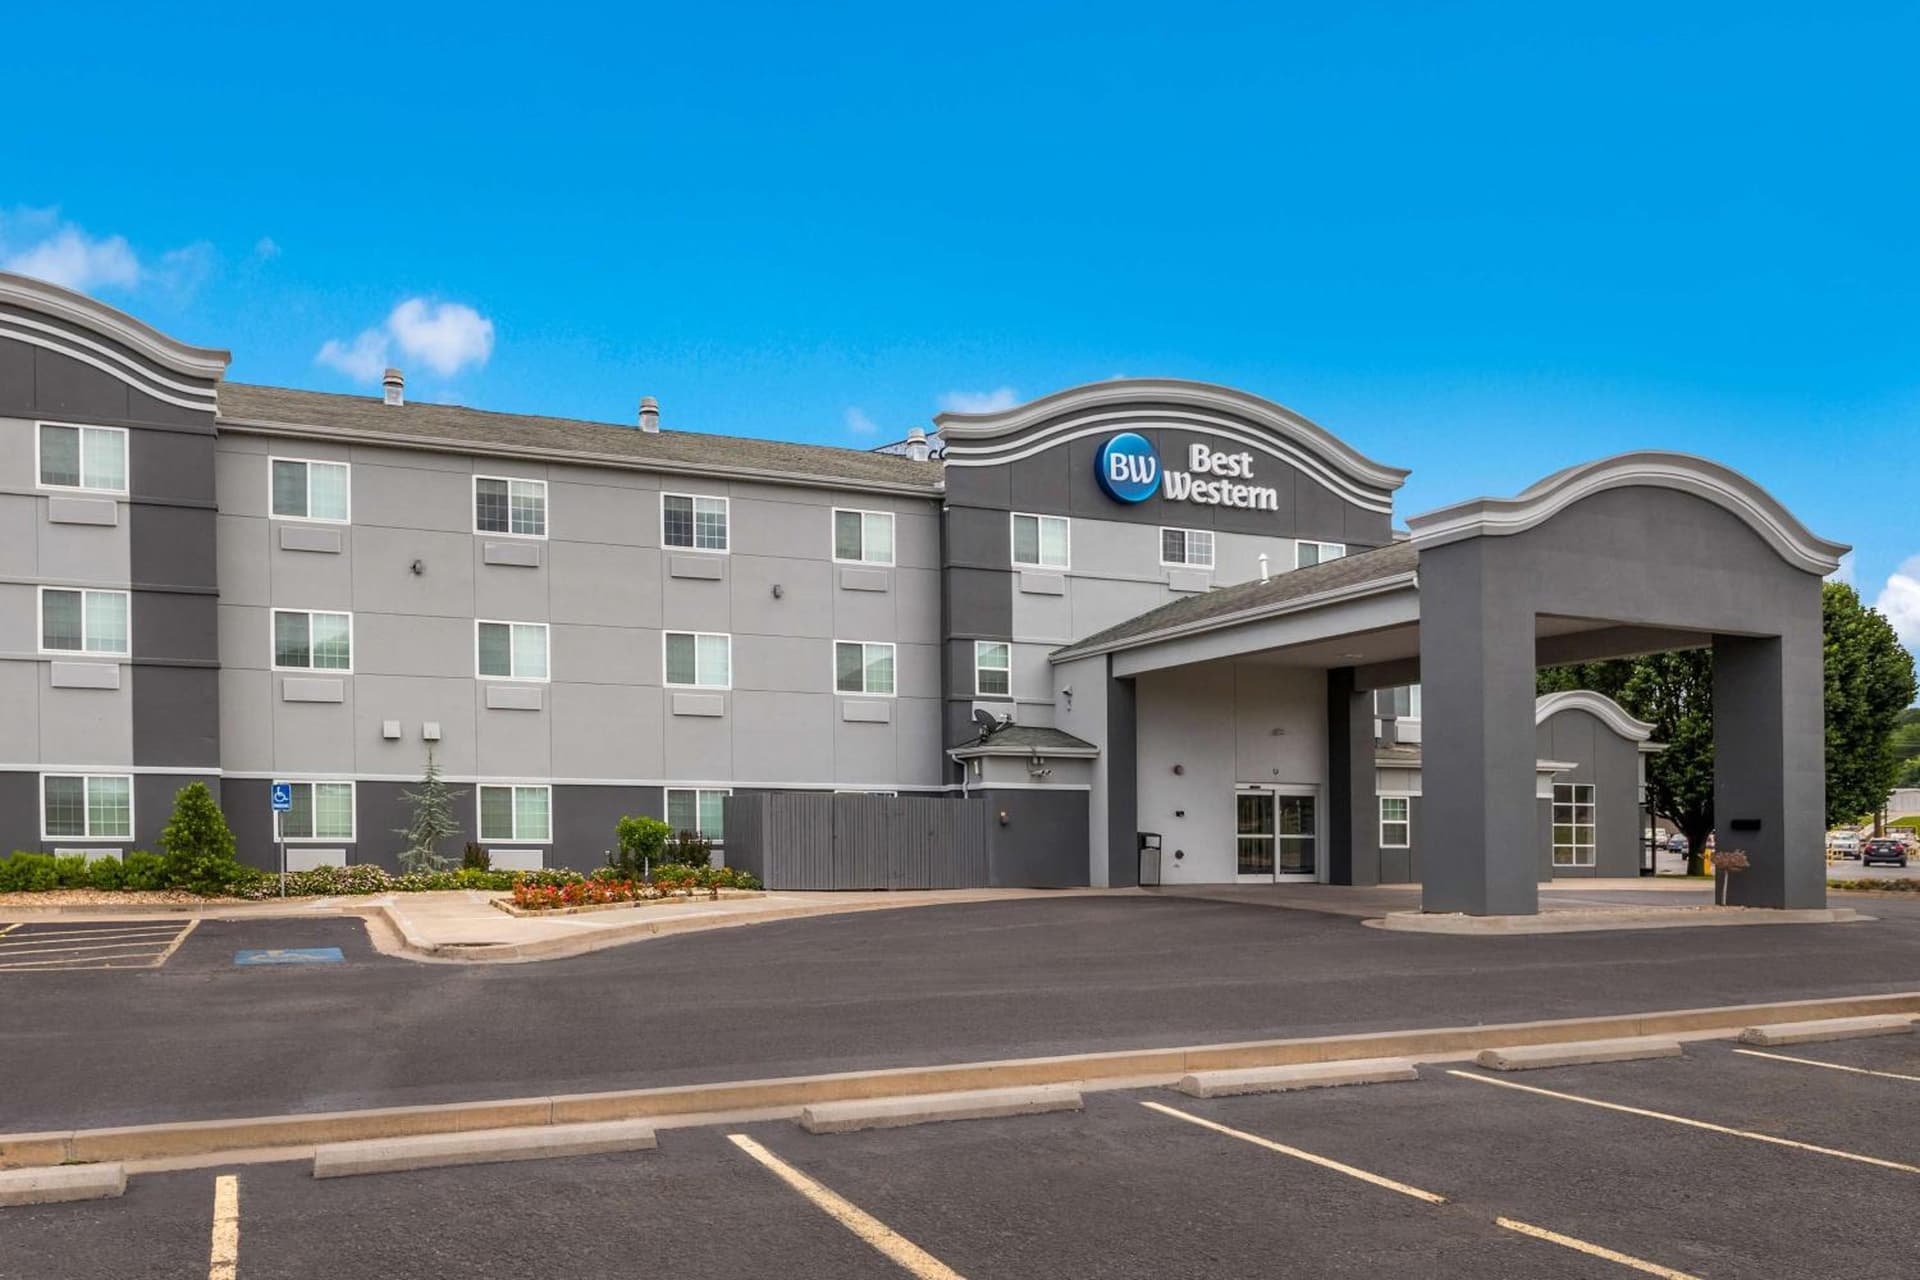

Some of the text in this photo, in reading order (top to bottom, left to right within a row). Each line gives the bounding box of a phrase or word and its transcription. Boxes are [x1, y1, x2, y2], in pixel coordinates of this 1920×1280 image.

[1109, 452, 1156, 484] BW
[1189, 443, 1254, 479] Best
[1163, 470, 1279, 511] Western
